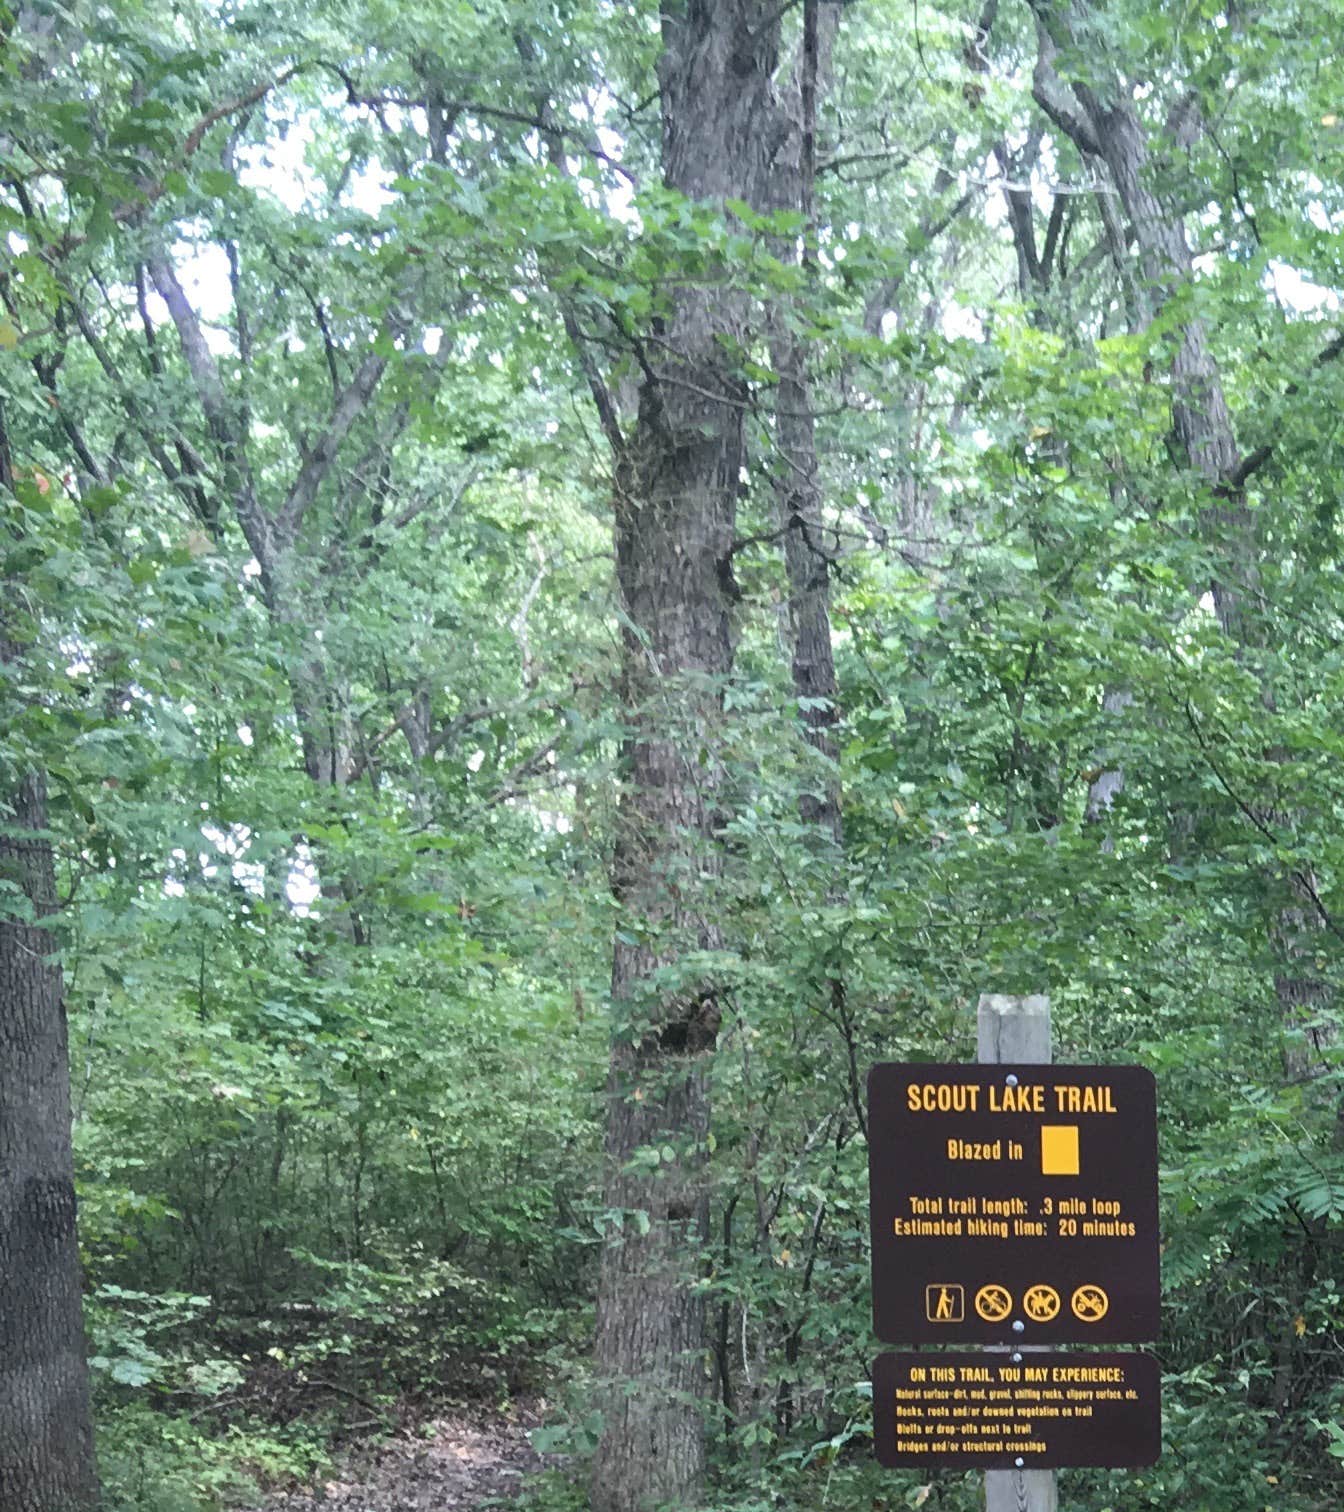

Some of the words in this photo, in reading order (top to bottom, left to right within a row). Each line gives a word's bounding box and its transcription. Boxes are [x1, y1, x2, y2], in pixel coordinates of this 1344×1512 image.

[907, 1084, 980, 1112] SCOUT
[989, 1085, 1045, 1113] LAKE
[1054, 1086, 1117, 1113] TRAIL
[947, 1139, 1001, 1160] Blazed
[1008, 1141, 1023, 1160] in
[909, 1196, 943, 1215] Total
[948, 1197, 976, 1215] trail
[982, 1197, 1028, 1217] length:
[1039, 1197, 1053, 1215] .3
[1058, 1198, 1087, 1215] mile
[1092, 1198, 1121, 1217] loop
[894, 1218, 962, 1236] Estimated
[967, 1218, 1009, 1238] hiking
[1014, 1219, 1047, 1236] time:
[1058, 1219, 1078, 1236] 20
[1082, 1219, 1136, 1237] minutes
[910, 1367, 926, 1382] ON
[929, 1367, 956, 1383] THIS
[960, 1367, 994, 1383] TRAIL,
[998, 1367, 1021, 1383] YOU
[1024, 1367, 1048, 1383] MAY
[1052, 1367, 1125, 1383] EXPERIENCE:
[896, 1388, 921, 1400] Natural
[1066, 1388, 1094, 1401] slippery
[896, 1406, 924, 1418] Rocks,
[927, 1407, 949, 1417] roots
[953, 1406, 980, 1417] and/or
[982, 1406, 1014, 1417] downed
[1017, 1406, 1060, 1418] vegetation
[1062, 1408, 1072, 1418] on
[1075, 1406, 1093, 1417] trail
[925, 1426, 934, 1435] or
[981, 1425, 1000, 1436] next
[1002, 1425, 1011, 1436] to
[1013, 1424, 1032, 1435] trail
[897, 1441, 928, 1453] Bridges
[931, 1441, 959, 1452] and/or
[962, 1441, 1003, 1453] structural
[1006, 1442, 1047, 1454] crossings
